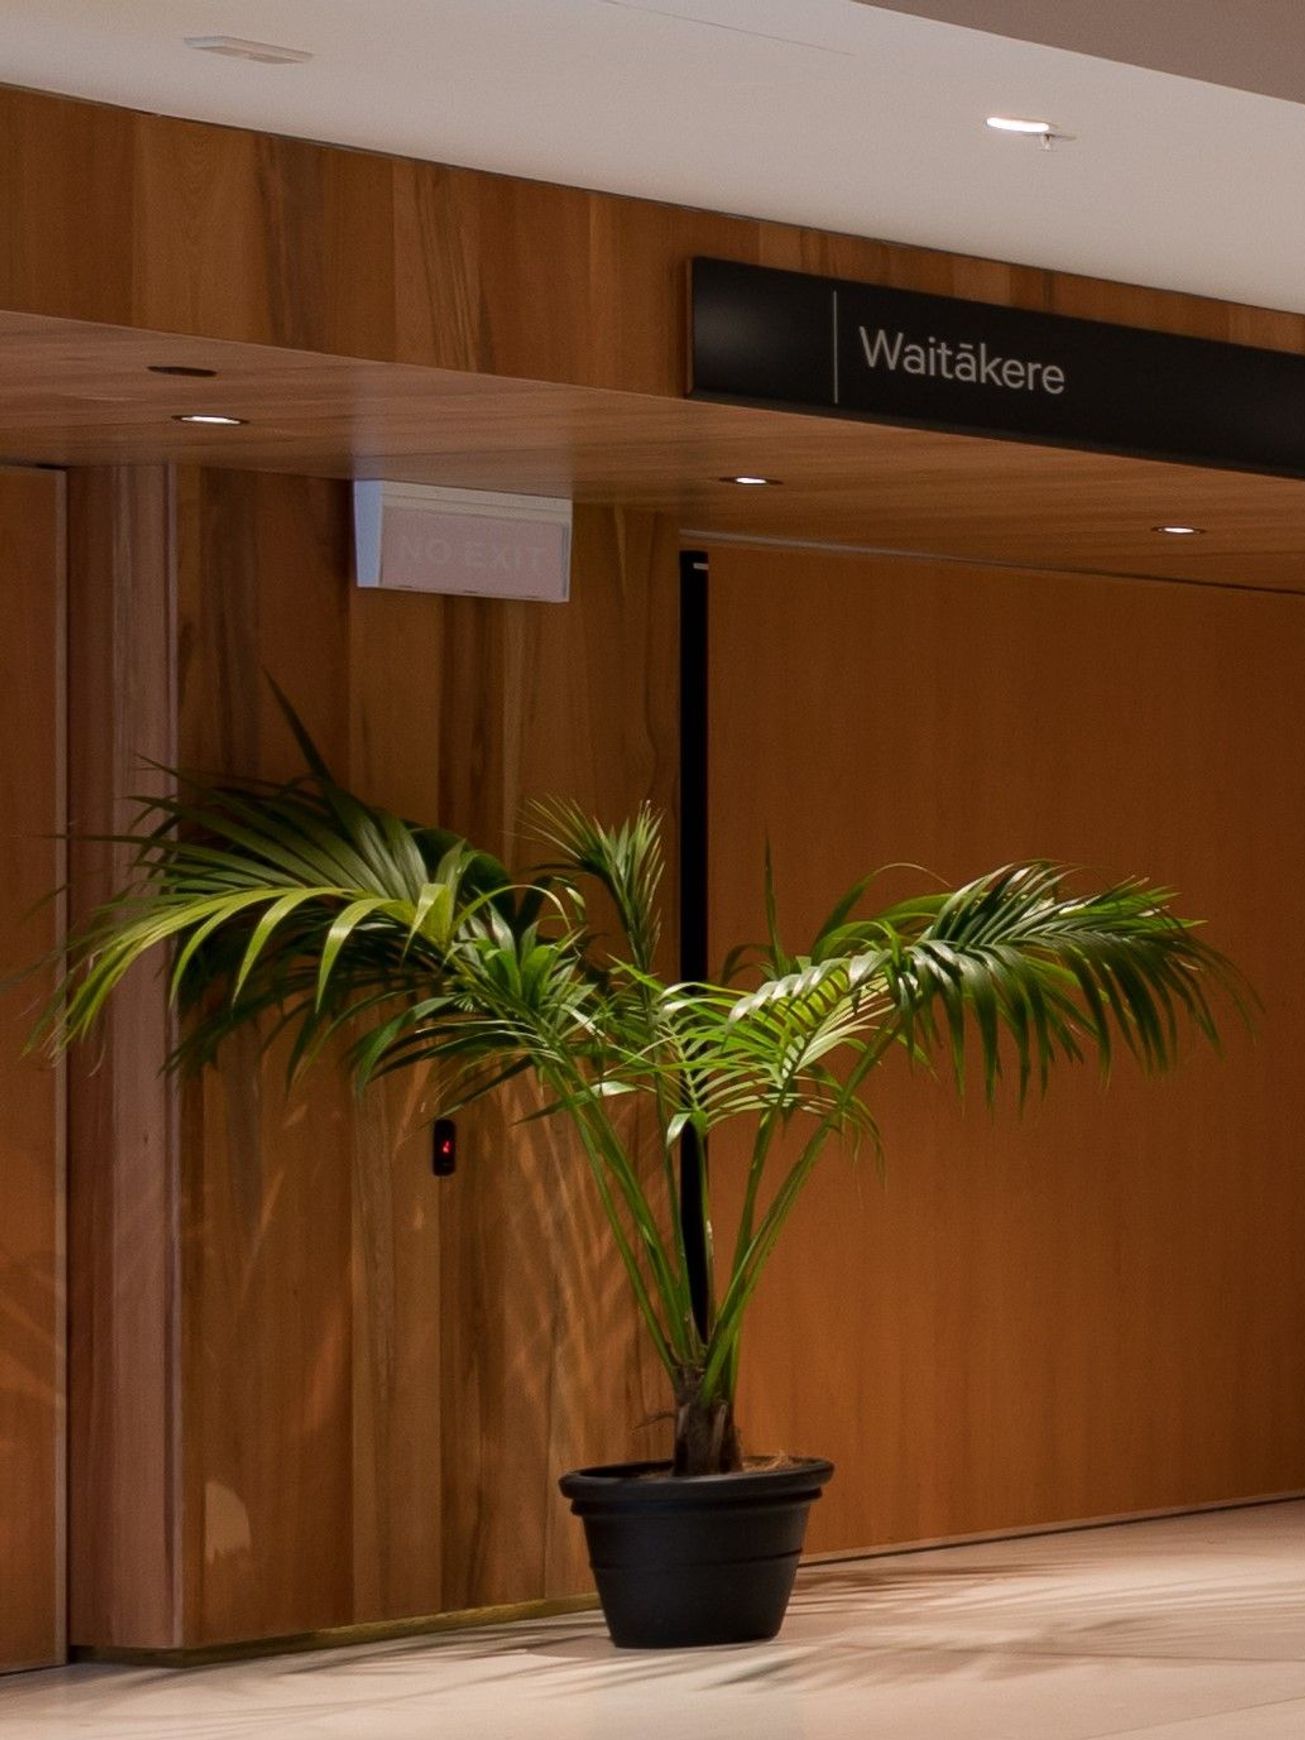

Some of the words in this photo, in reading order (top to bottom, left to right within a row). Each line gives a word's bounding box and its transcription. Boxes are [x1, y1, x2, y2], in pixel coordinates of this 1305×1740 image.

[859, 326, 1065, 394] Waitākere
[400, 534, 452, 564] NO
[464, 541, 547, 571] EXIT
